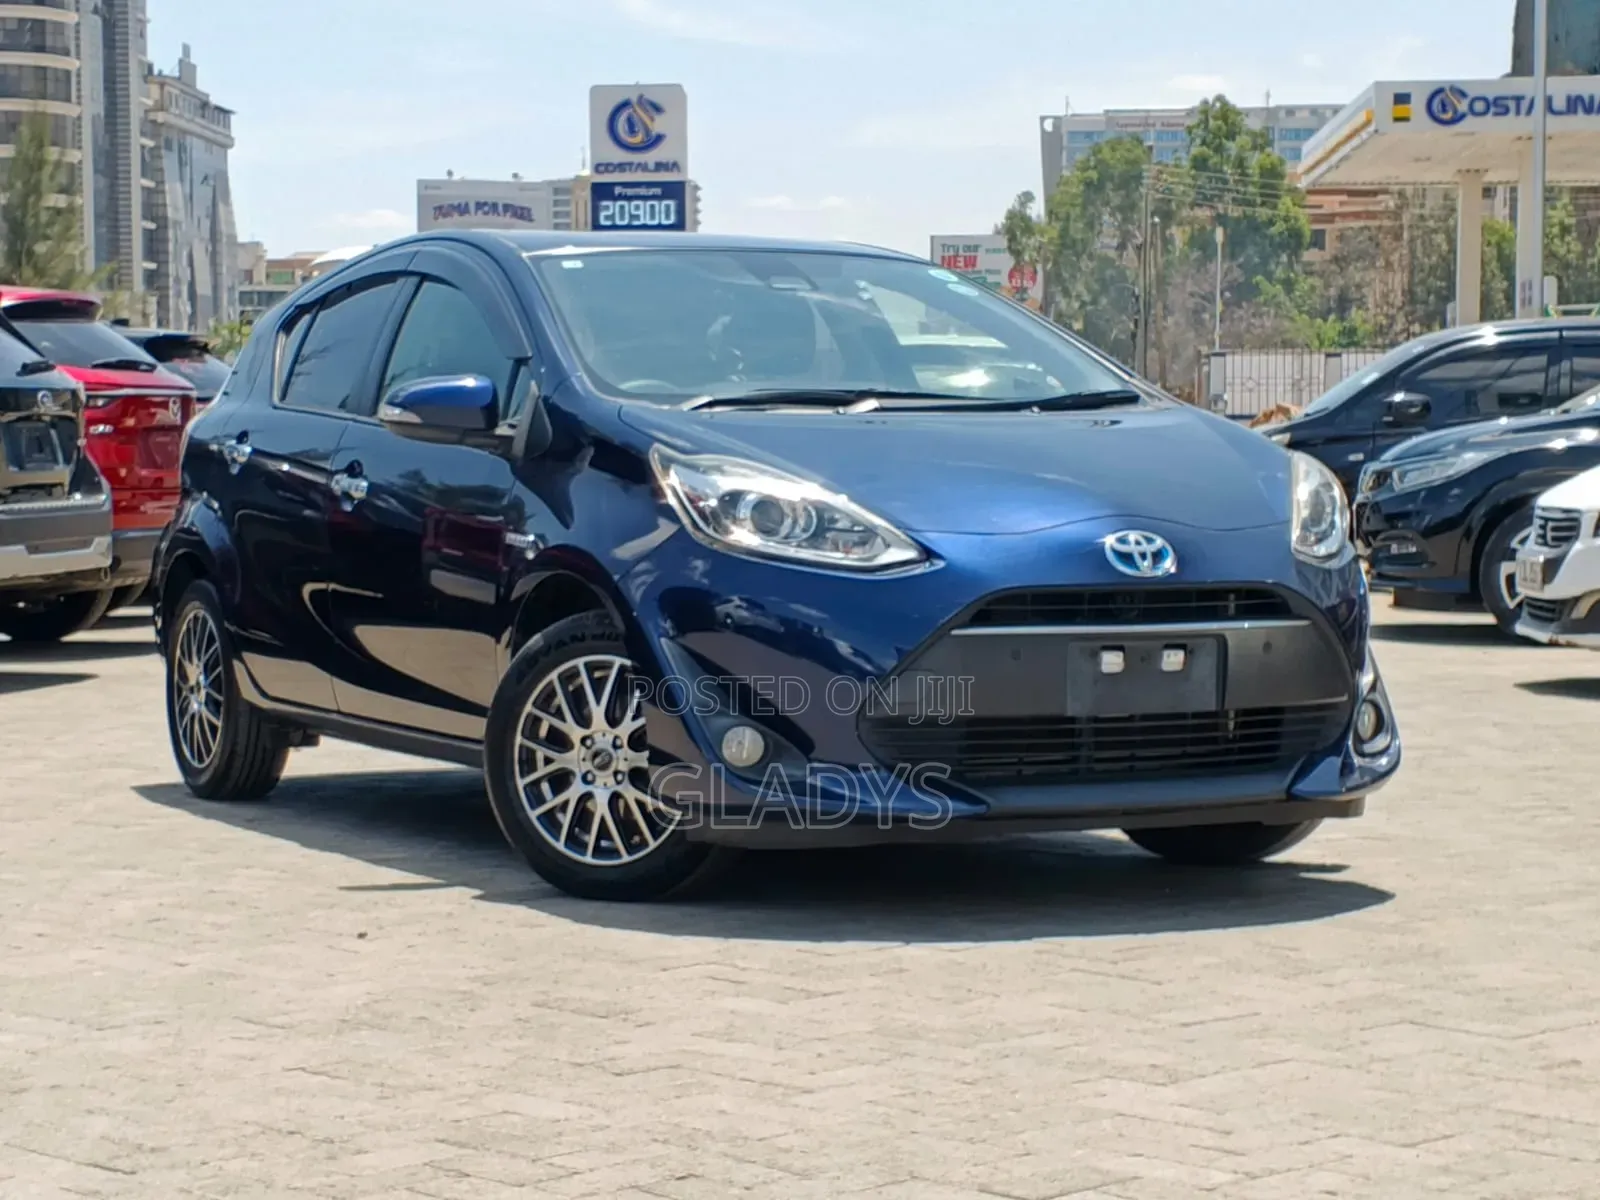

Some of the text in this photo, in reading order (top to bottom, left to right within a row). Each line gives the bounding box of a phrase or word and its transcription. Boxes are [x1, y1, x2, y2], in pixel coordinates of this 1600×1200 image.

[1426, 84, 1600, 126] COSTLIN
[594, 160, 681, 175] COSTALINA
[614, 186, 662, 197] Premium
[941, 243, 960, 256] Try
[941, 255, 977, 270] NEW
